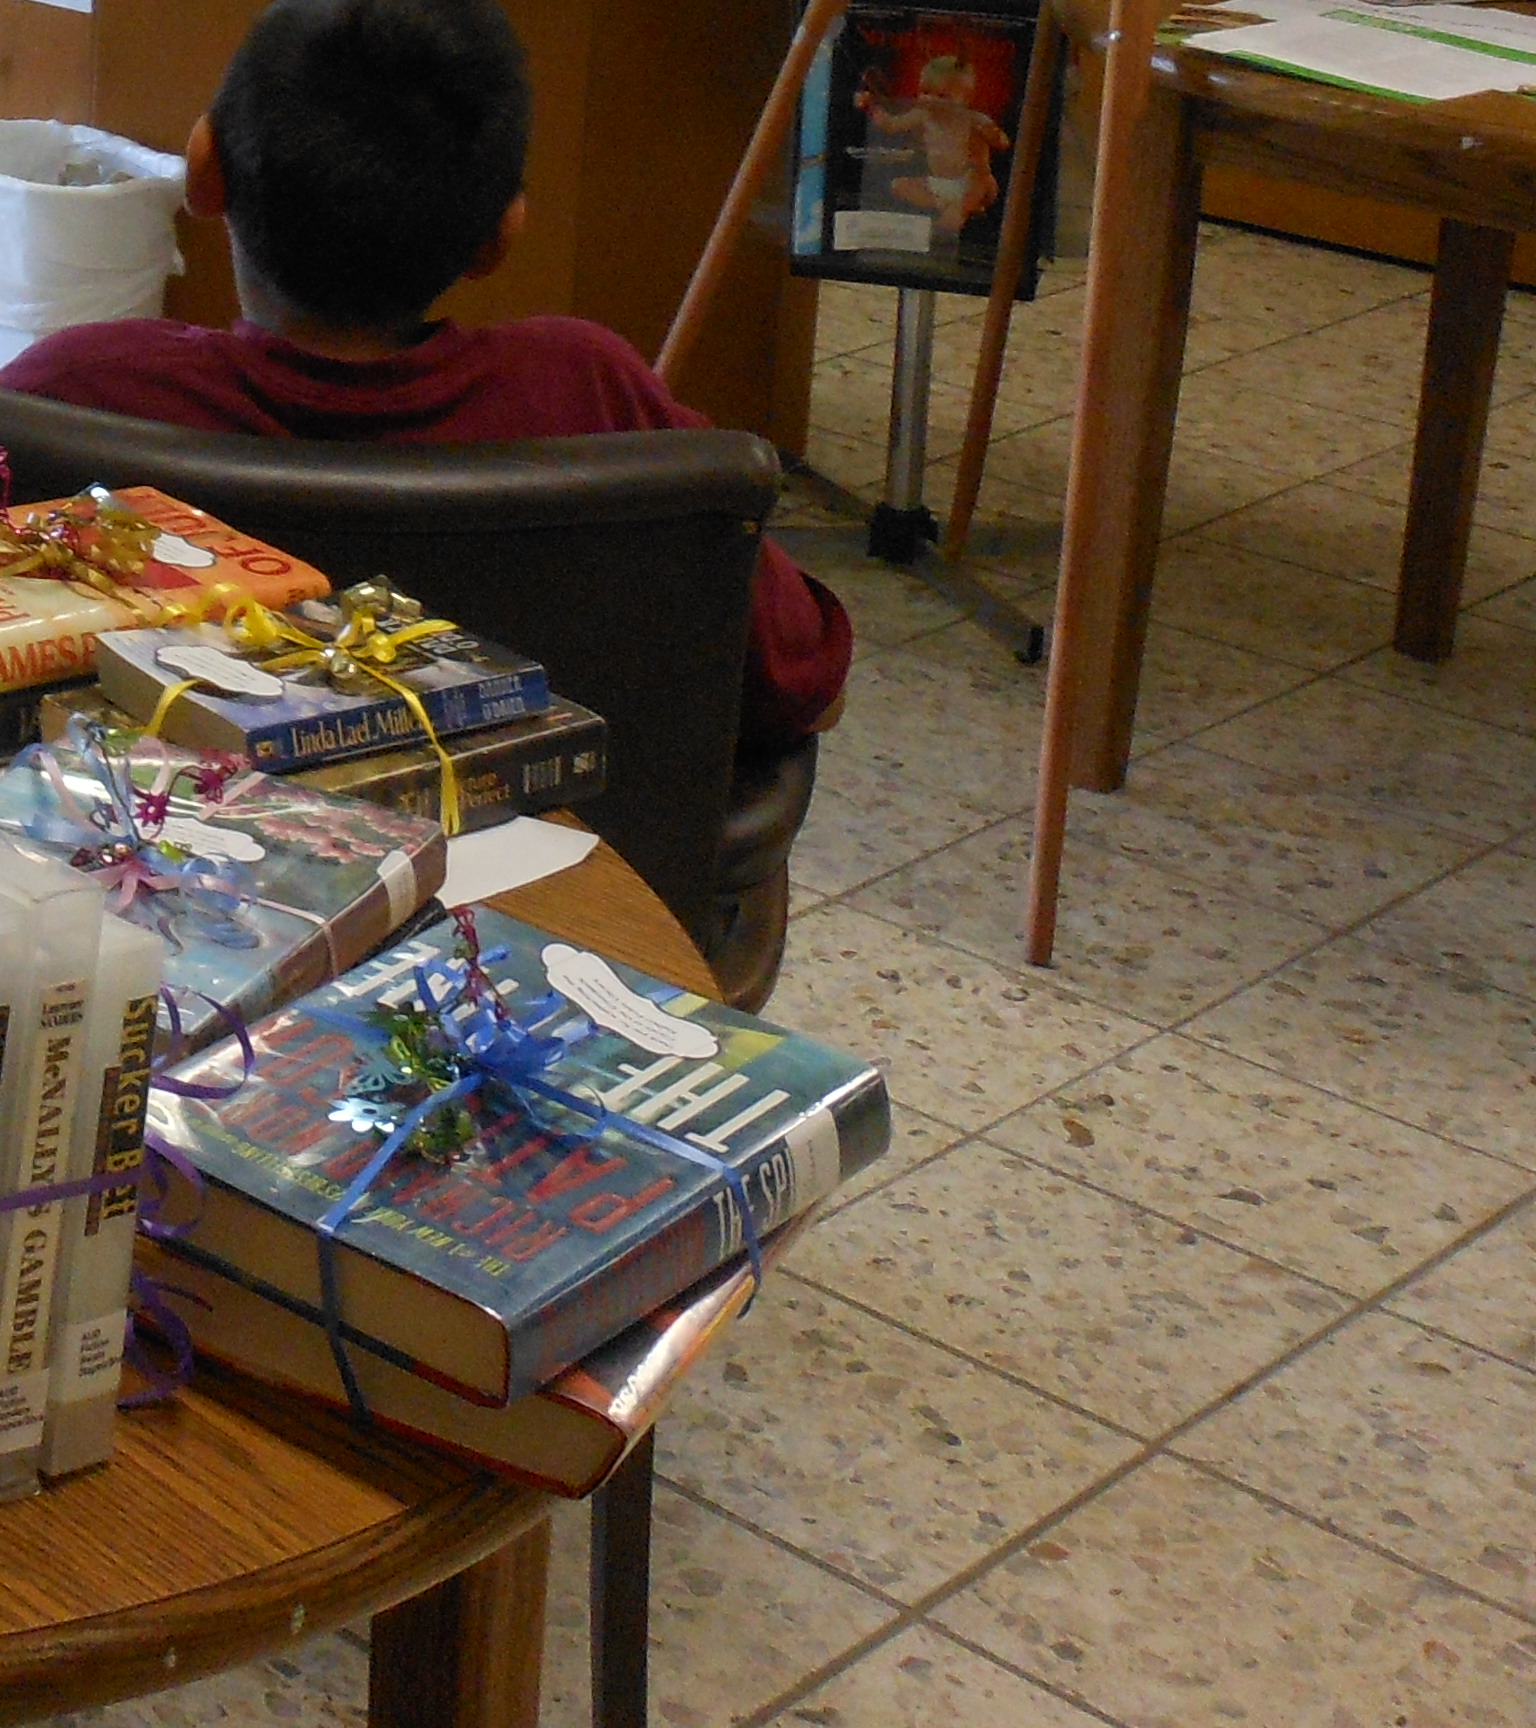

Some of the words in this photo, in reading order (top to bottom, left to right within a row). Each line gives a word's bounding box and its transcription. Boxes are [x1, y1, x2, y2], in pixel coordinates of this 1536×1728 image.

[291, 724, 337, 759] Linda
[338, 715, 372, 748] Lael
[110, 996, 157, 1136] Sucker
[8, 1228, 49, 1374] GAMBLE
